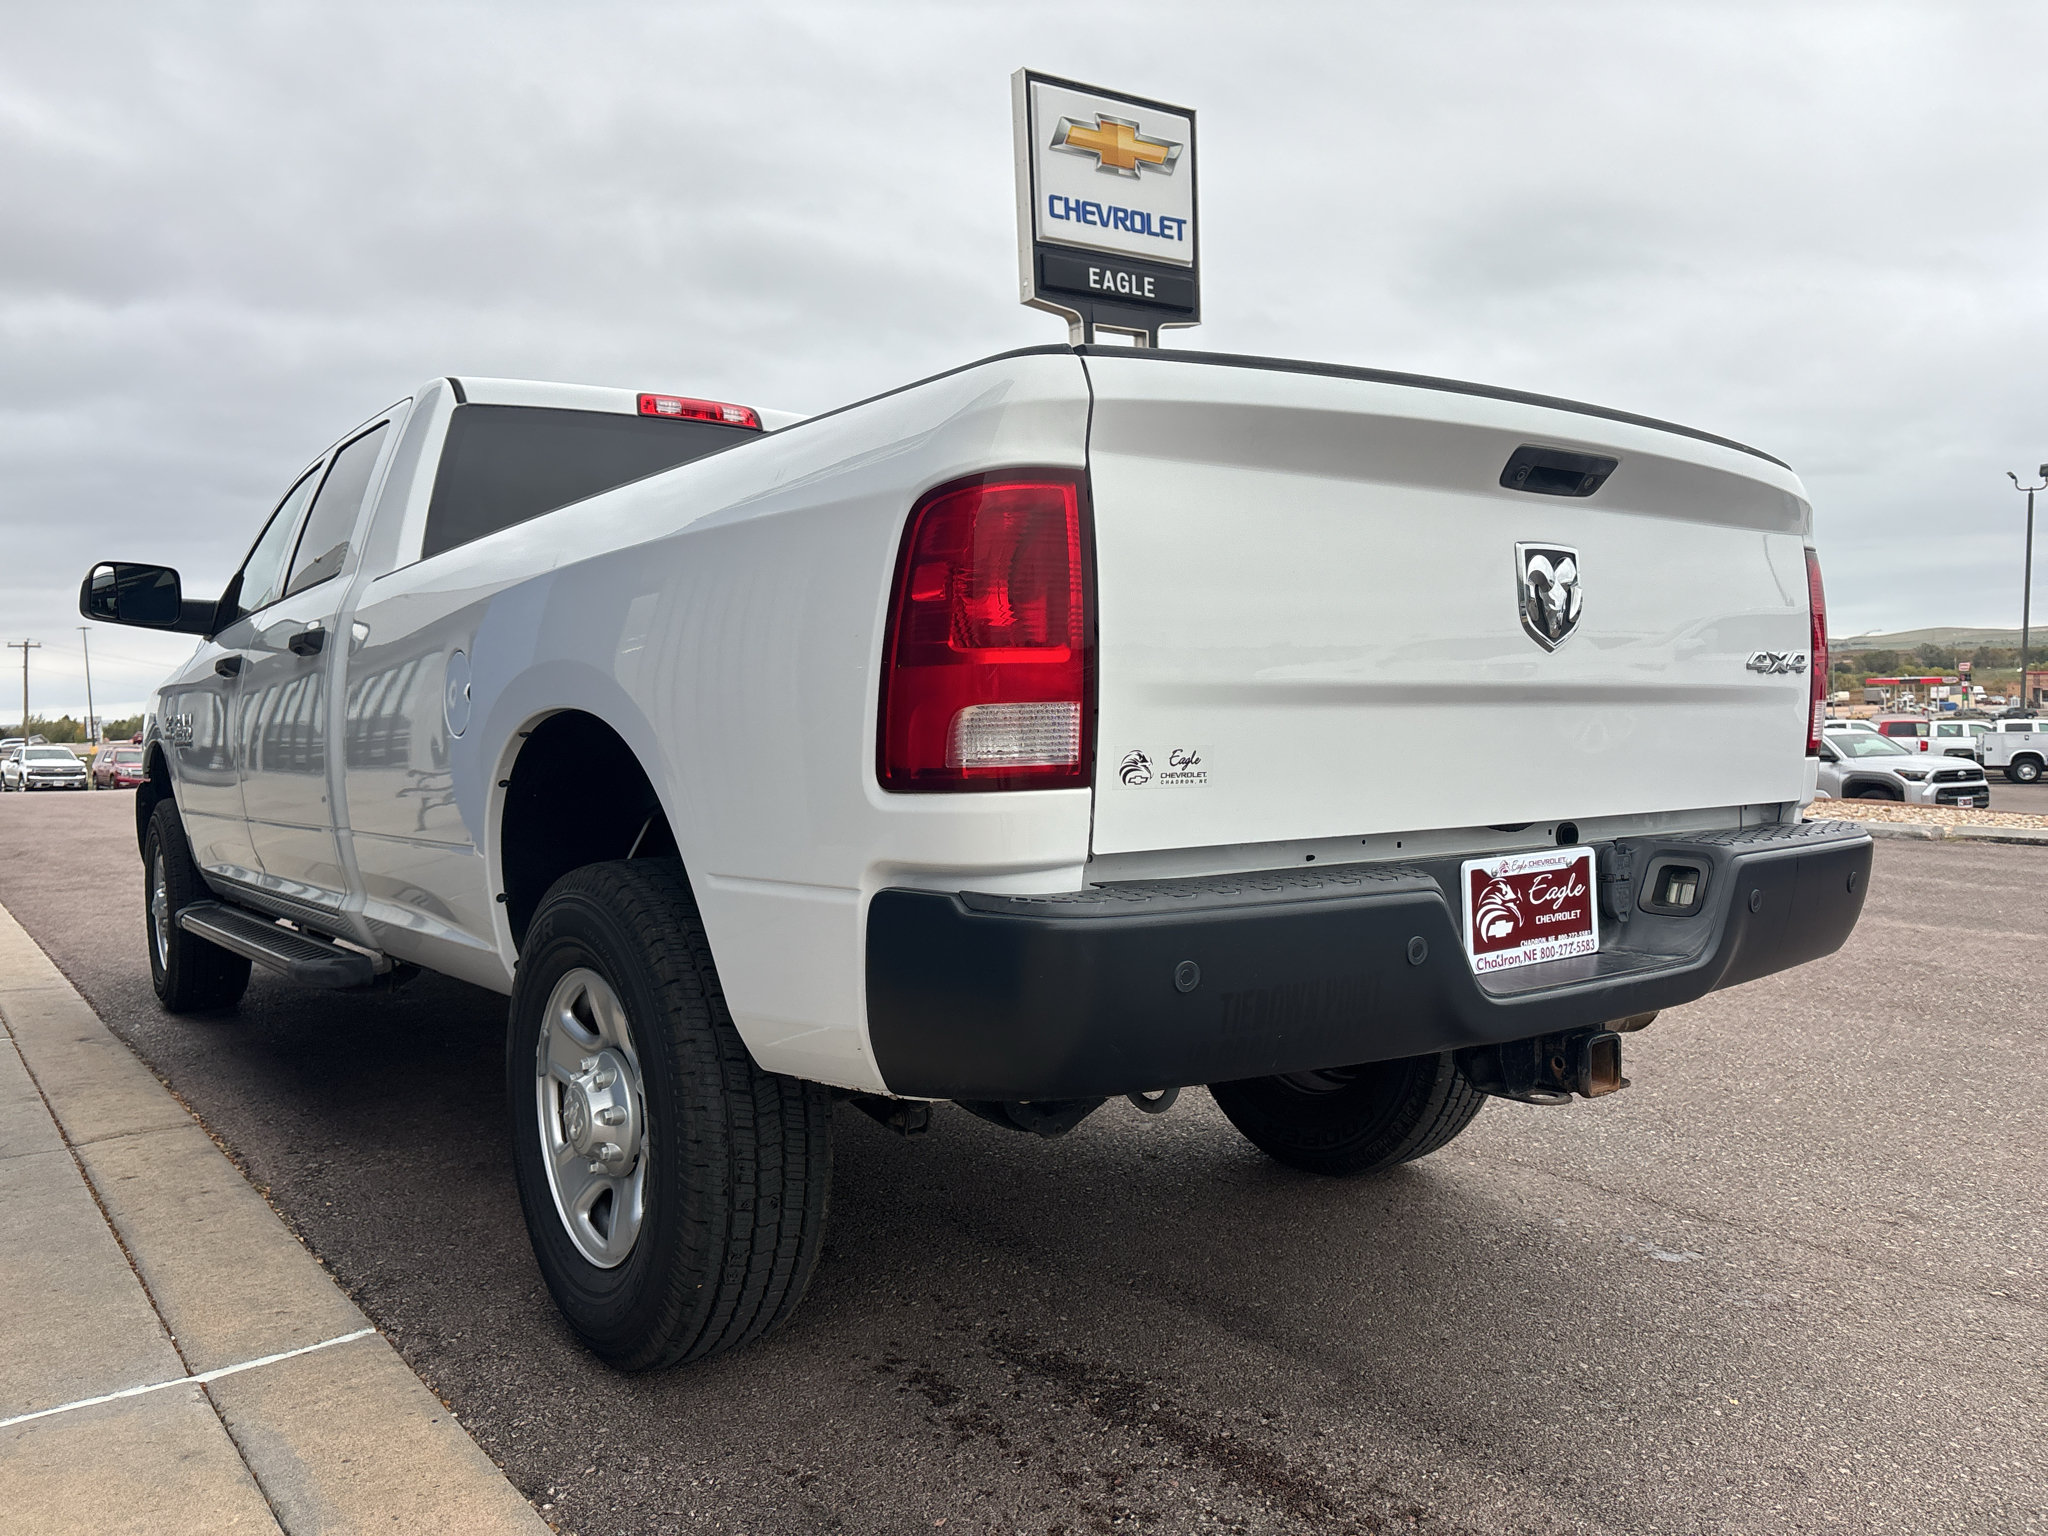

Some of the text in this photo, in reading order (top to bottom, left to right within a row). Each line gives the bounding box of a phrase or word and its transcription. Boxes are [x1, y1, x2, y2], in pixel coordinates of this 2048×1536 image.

[1048, 194, 1187, 241] CHEVROLET
[1088, 266, 1156, 298] EAGLE
[1169, 748, 1202, 771] Eagle
[1511, 856, 1567, 874] Eagle CHEVROLET
[1528, 872, 1586, 910] Eagle
[1535, 909, 1582, 925] CHEVROLET
[1540, 938, 1596, 960] 800-272-5583
